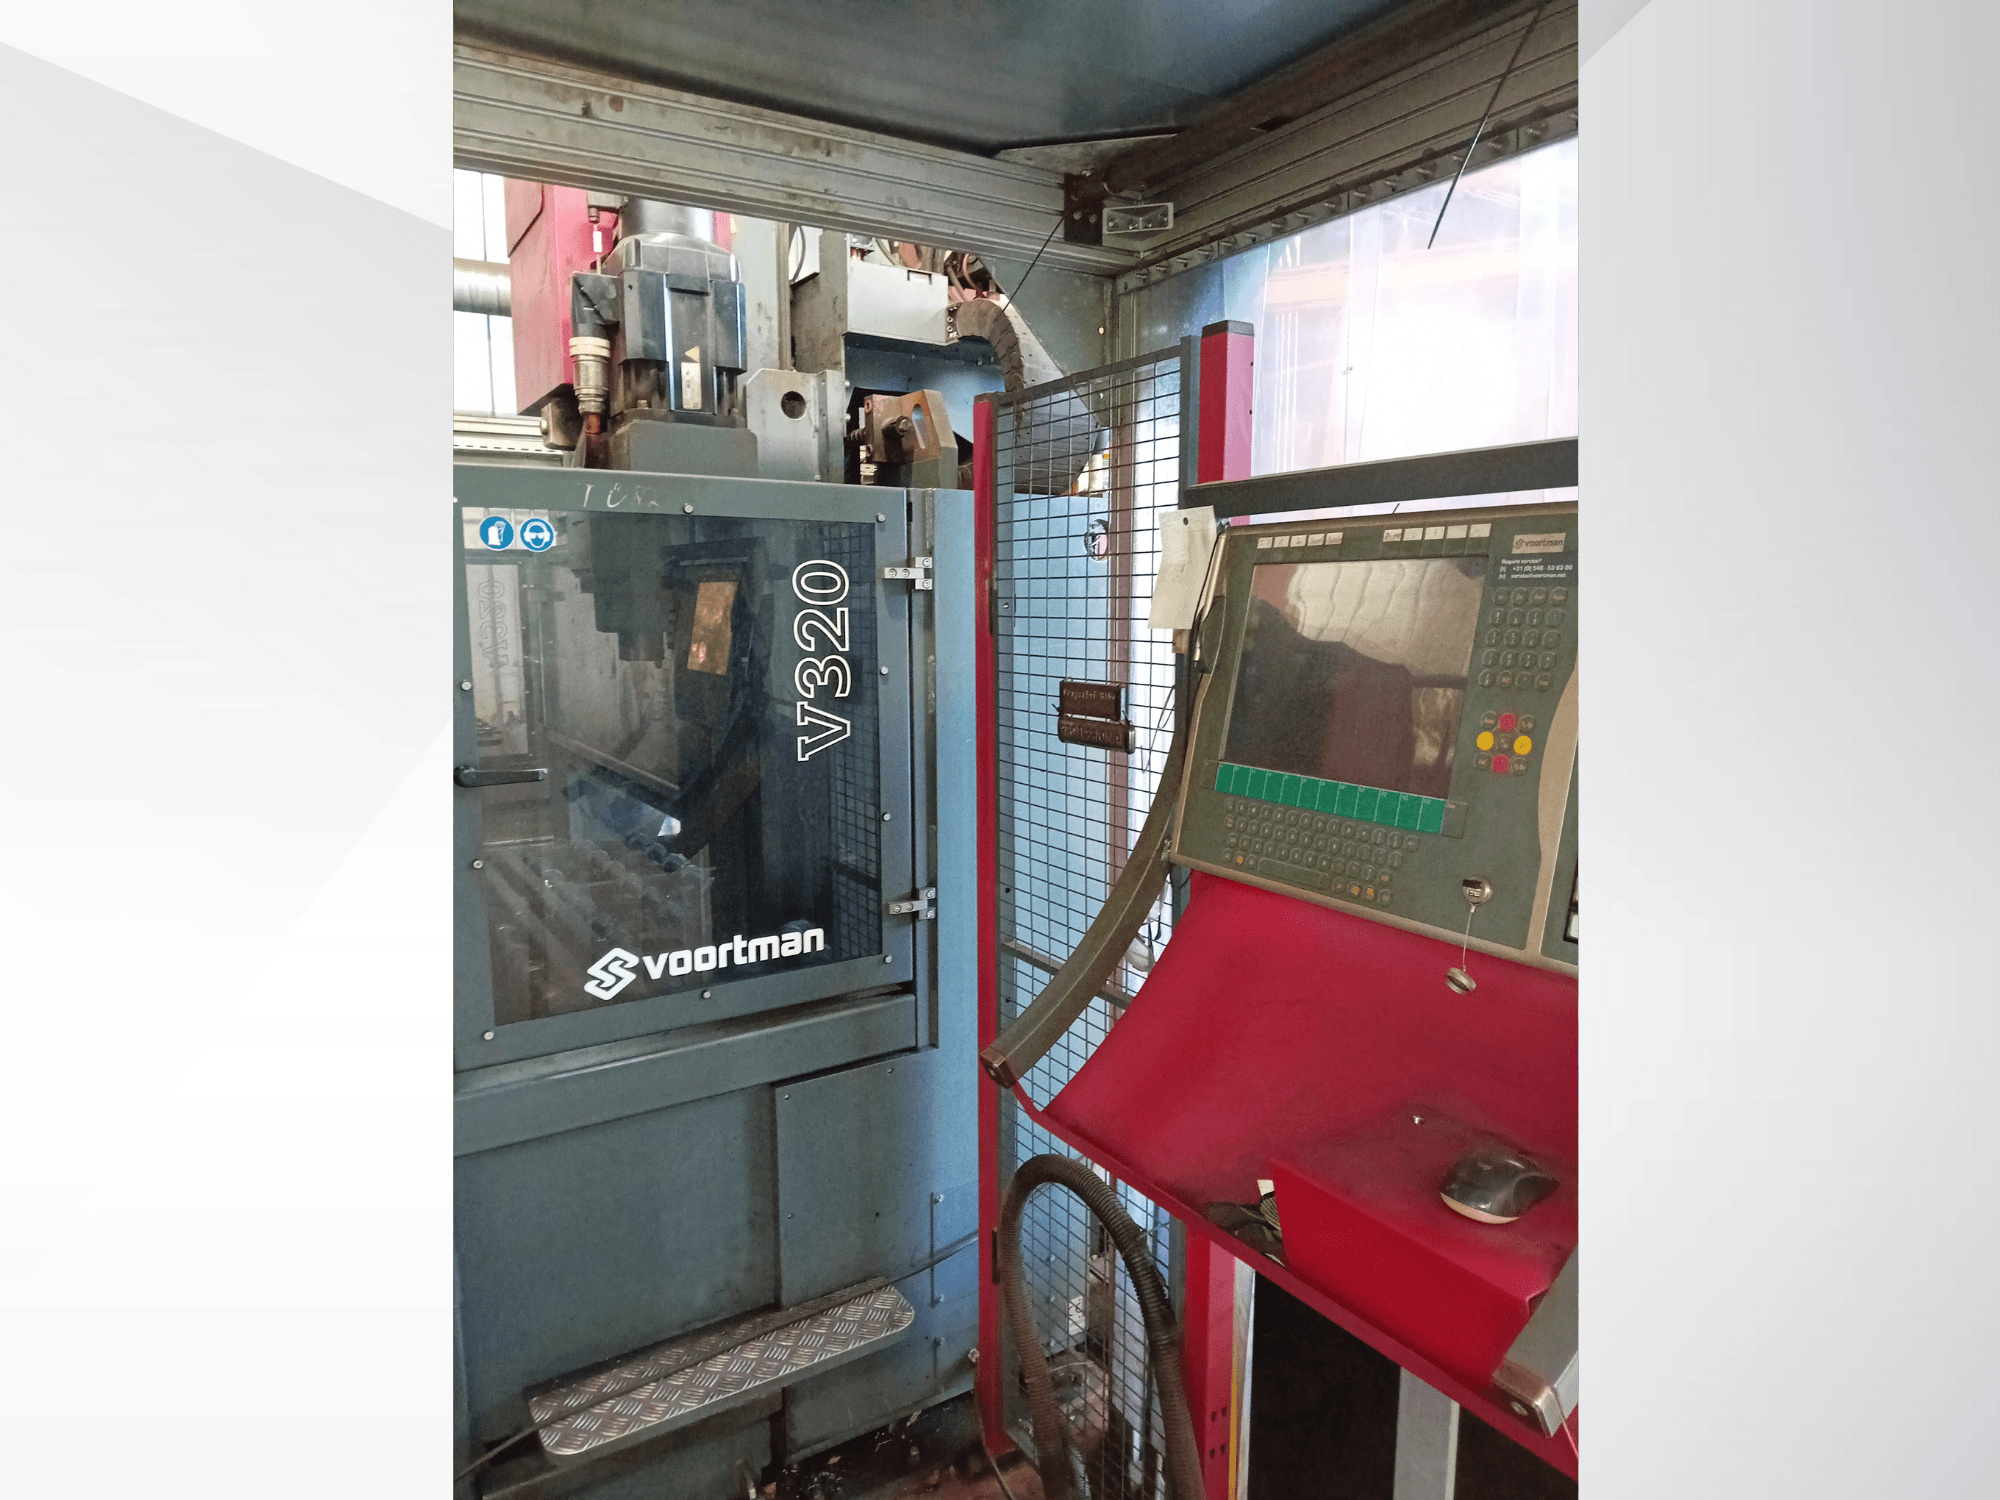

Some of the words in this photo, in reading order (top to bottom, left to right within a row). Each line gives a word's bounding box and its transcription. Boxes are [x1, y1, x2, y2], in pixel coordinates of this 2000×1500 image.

[1525, 539, 1564, 547] voortman
[792, 559, 851, 762] V320
[641, 927, 825, 980] voortman
